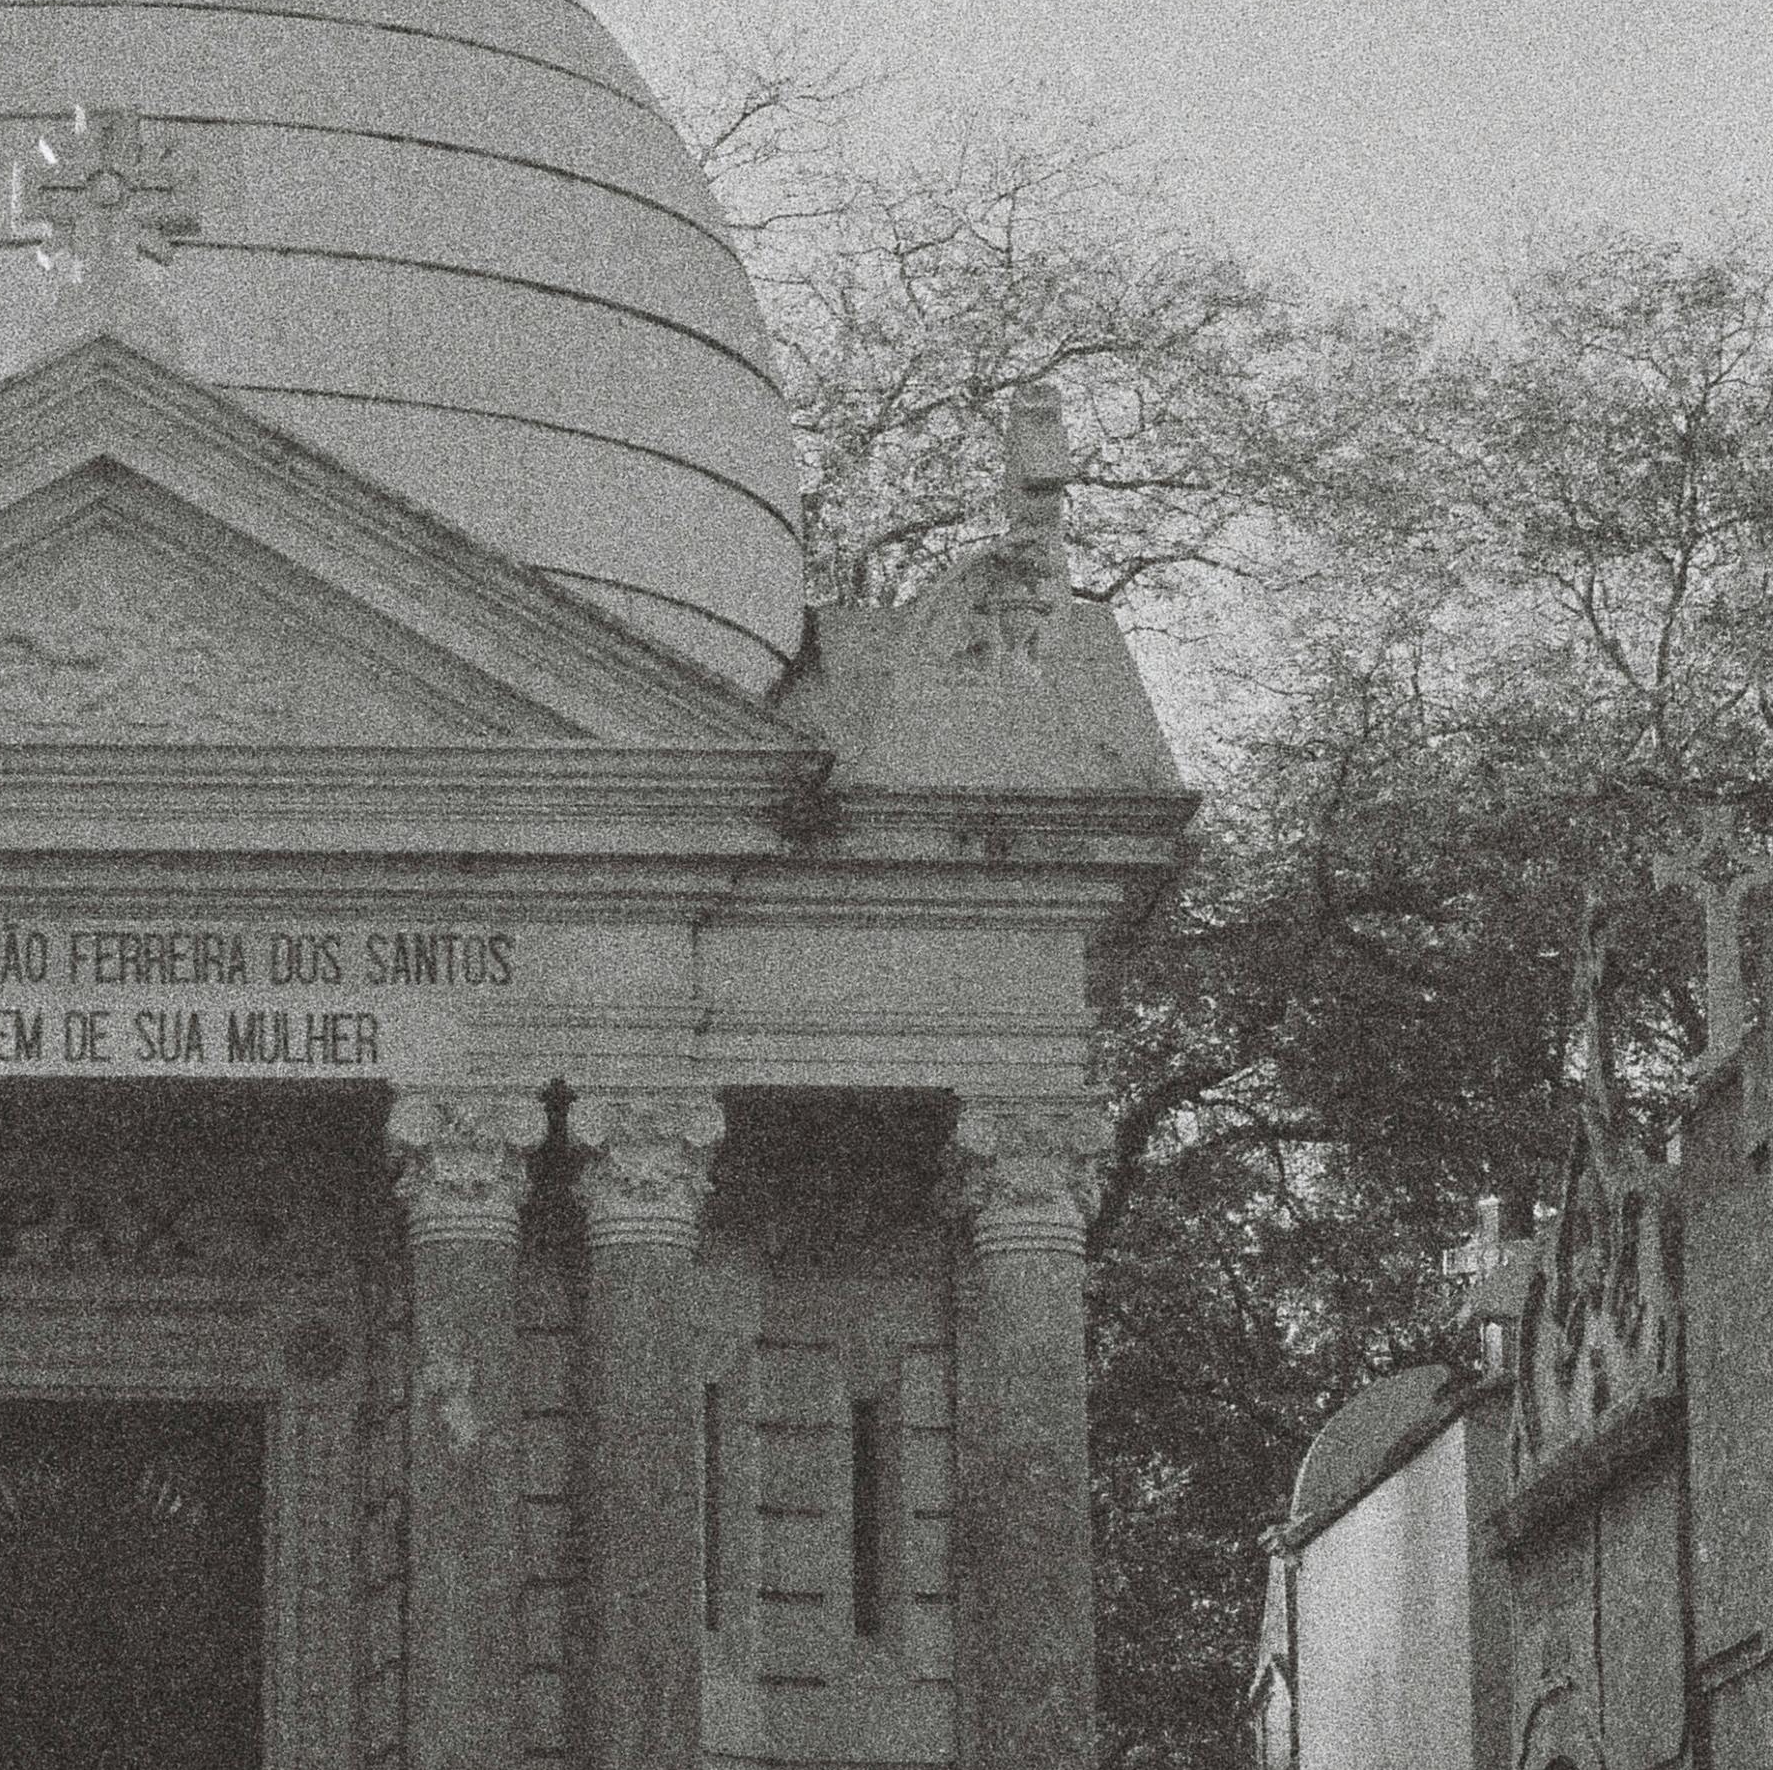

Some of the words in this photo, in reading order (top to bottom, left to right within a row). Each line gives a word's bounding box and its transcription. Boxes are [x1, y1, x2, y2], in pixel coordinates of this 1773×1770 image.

[68, 929, 247, 985] FERREIRA
[270, 932, 343, 986] DOS
[365, 934, 514, 987] SANTOS
[65, 1010, 112, 1063] DE
[135, 1011, 204, 1064] SUA
[227, 1013, 380, 1066] MULHER
